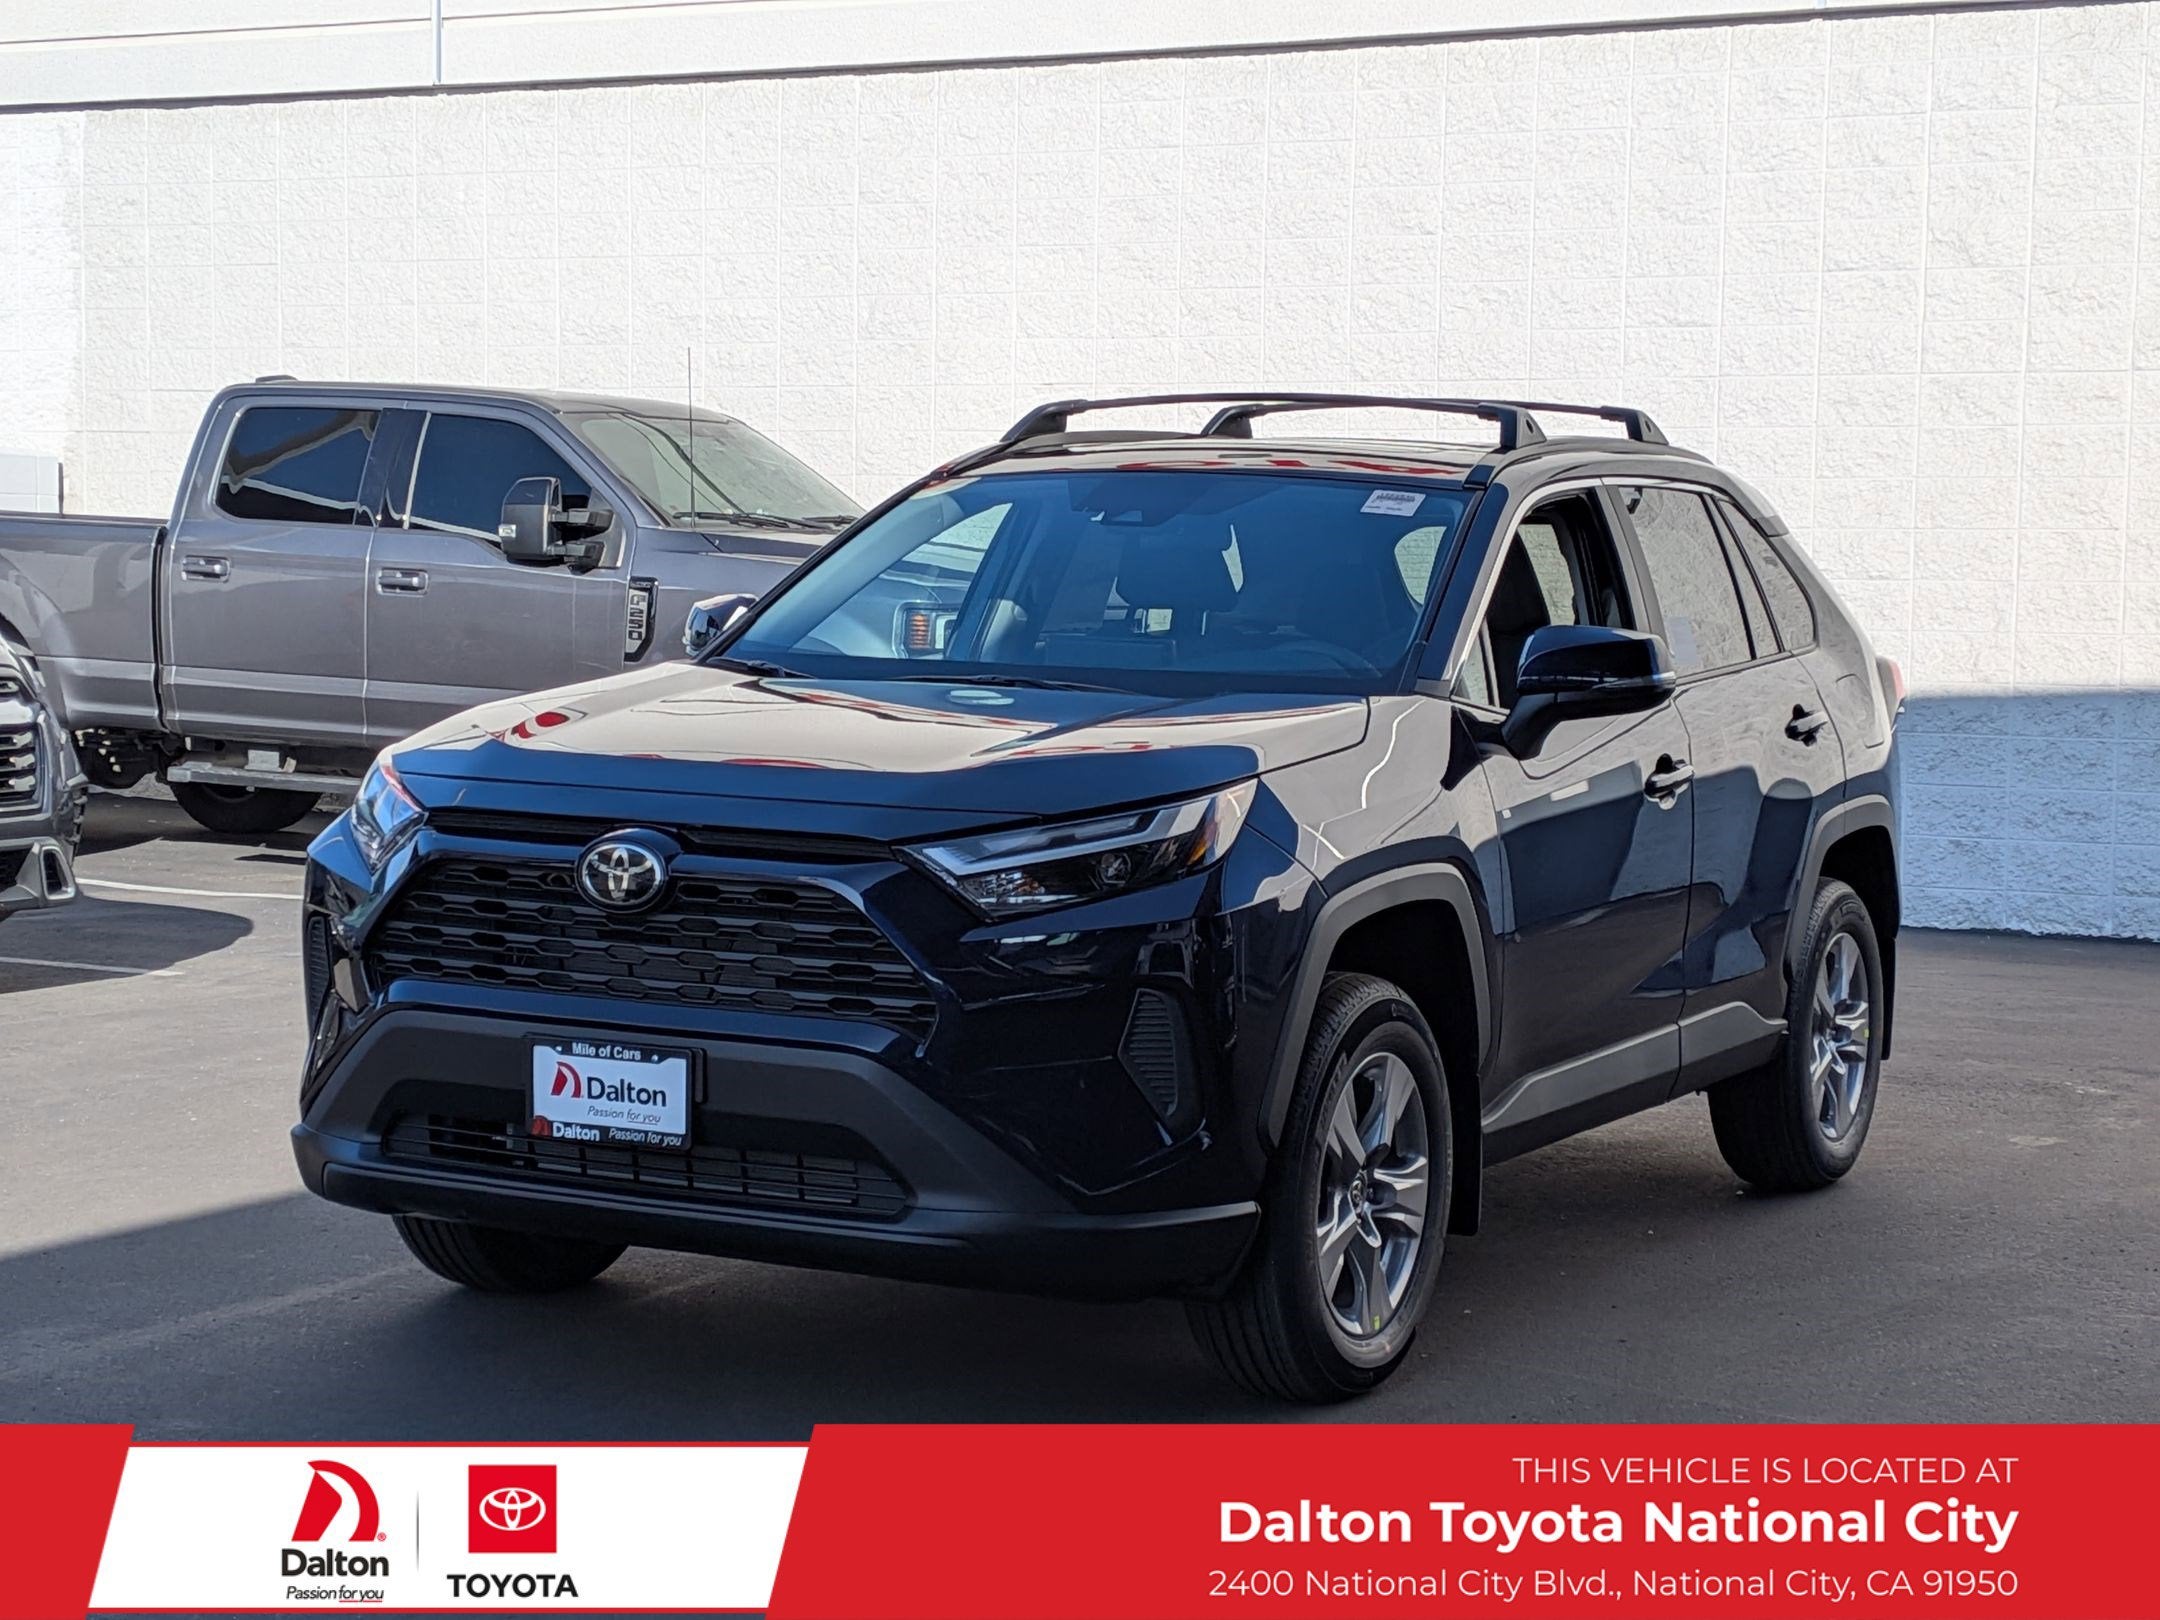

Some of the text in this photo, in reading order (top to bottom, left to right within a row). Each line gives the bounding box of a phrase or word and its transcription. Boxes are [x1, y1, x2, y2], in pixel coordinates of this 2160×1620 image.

[628, 594, 646, 640] F250
[572, 1042, 642, 1061] Mile of Cars
[587, 1076, 667, 1107] Dalton
[587, 1106, 661, 1123] Passion for you
[552, 1122, 600, 1141] Dalton
[608, 1128, 682, 1147] Passion for you
